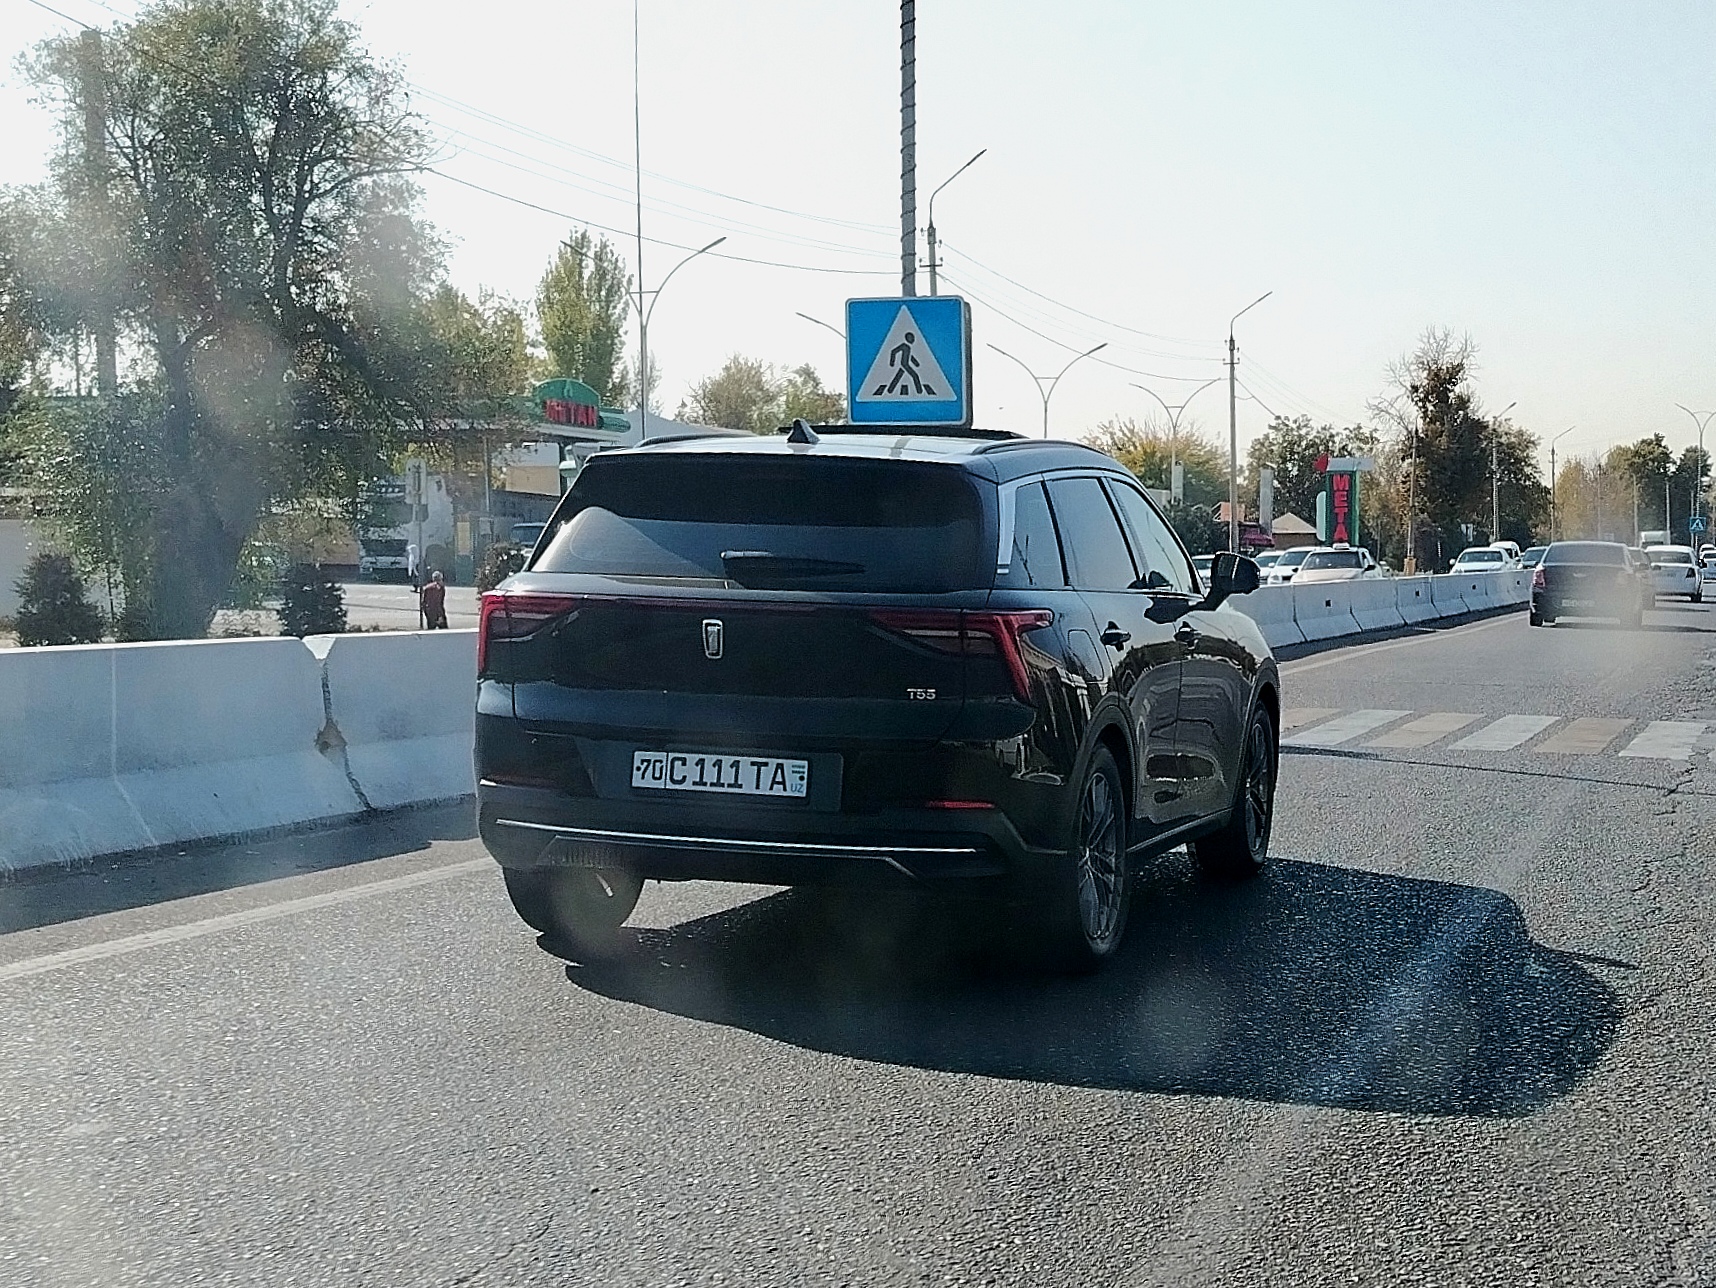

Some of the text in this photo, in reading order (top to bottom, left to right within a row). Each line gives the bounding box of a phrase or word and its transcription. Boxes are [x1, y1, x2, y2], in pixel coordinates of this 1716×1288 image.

[906, 688, 936, 700] T55
[639, 758, 665, 781] 70
[790, 782, 805, 794] UZ
